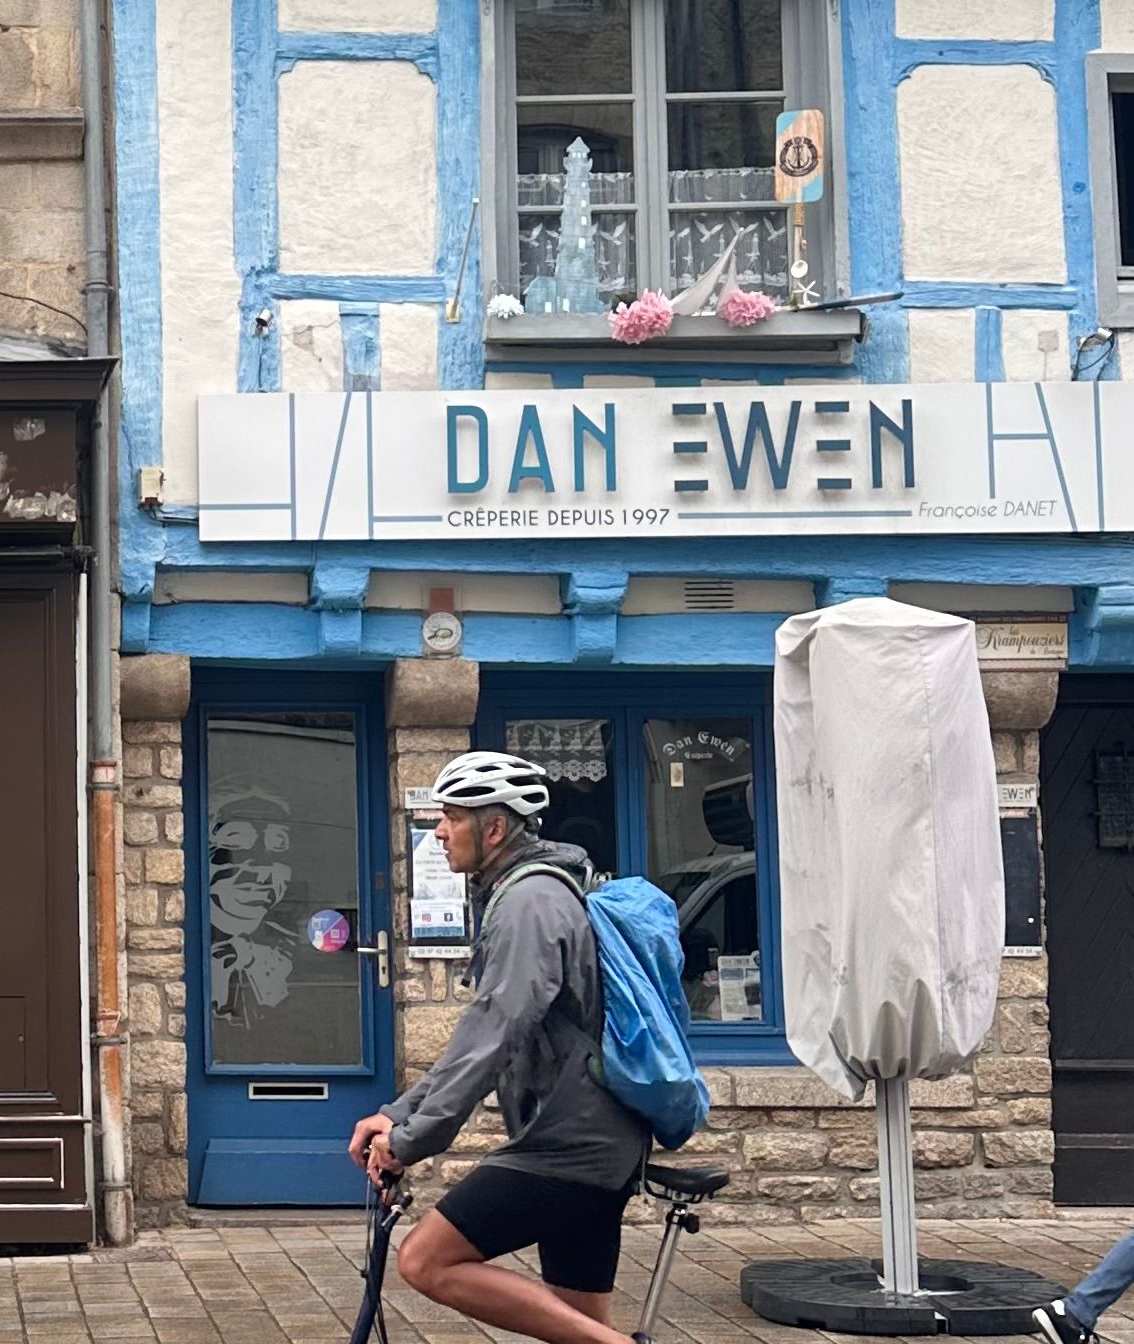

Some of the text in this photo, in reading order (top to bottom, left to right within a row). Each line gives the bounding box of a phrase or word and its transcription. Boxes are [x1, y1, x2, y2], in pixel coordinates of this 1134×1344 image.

[447, 399, 916, 493] DAN EWEN
[447, 506, 670, 527] CRÊPERIE DEPUIS 1997
[918, 500, 1057, 519] Françoise DANET
[662, 730, 735, 756] Dan Ewen
[1002, 787, 1032, 800] EWEN
